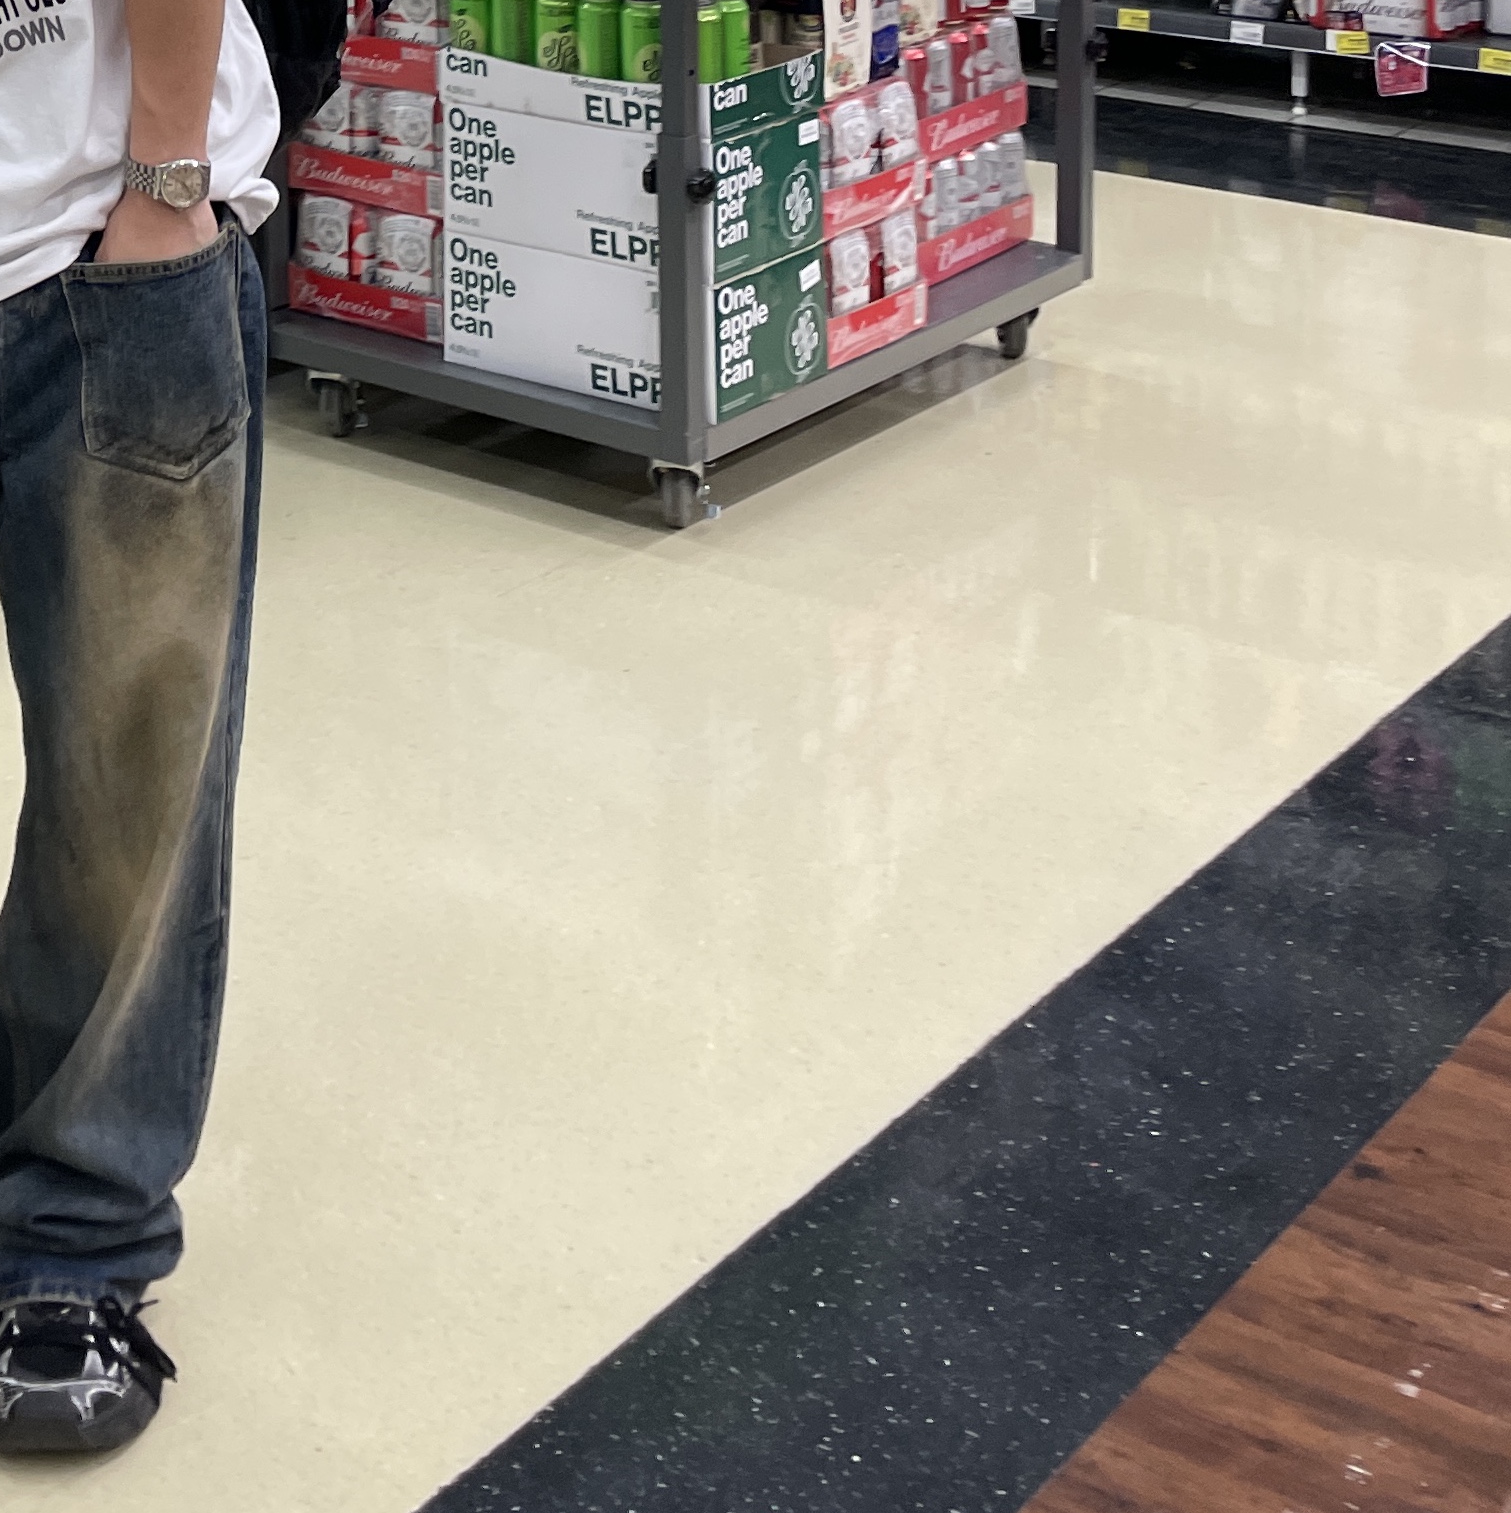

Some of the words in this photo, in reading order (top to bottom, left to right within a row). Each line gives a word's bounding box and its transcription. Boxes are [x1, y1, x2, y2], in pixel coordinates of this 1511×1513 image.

[446, 52, 488, 77] can
[713, 80, 748, 110] can
[448, 108, 498, 137] One
[449, 138, 515, 167] apple
[715, 145, 752, 173] One
[296, 153, 394, 196] Budweiser
[450, 161, 488, 185] per
[716, 163, 763, 201] apple
[450, 184, 493, 208] can
[716, 195, 747, 225] per
[716, 221, 749, 249] can
[450, 237, 498, 268] One
[450, 268, 516, 298] apple
[294, 280, 392, 323] Budweiser
[450, 289, 490, 314] per
[718, 284, 756, 313] One
[450, 314, 493, 338] can
[719, 303, 768, 341] apple
[719, 338, 752, 368] per
[720, 359, 754, 390] can
